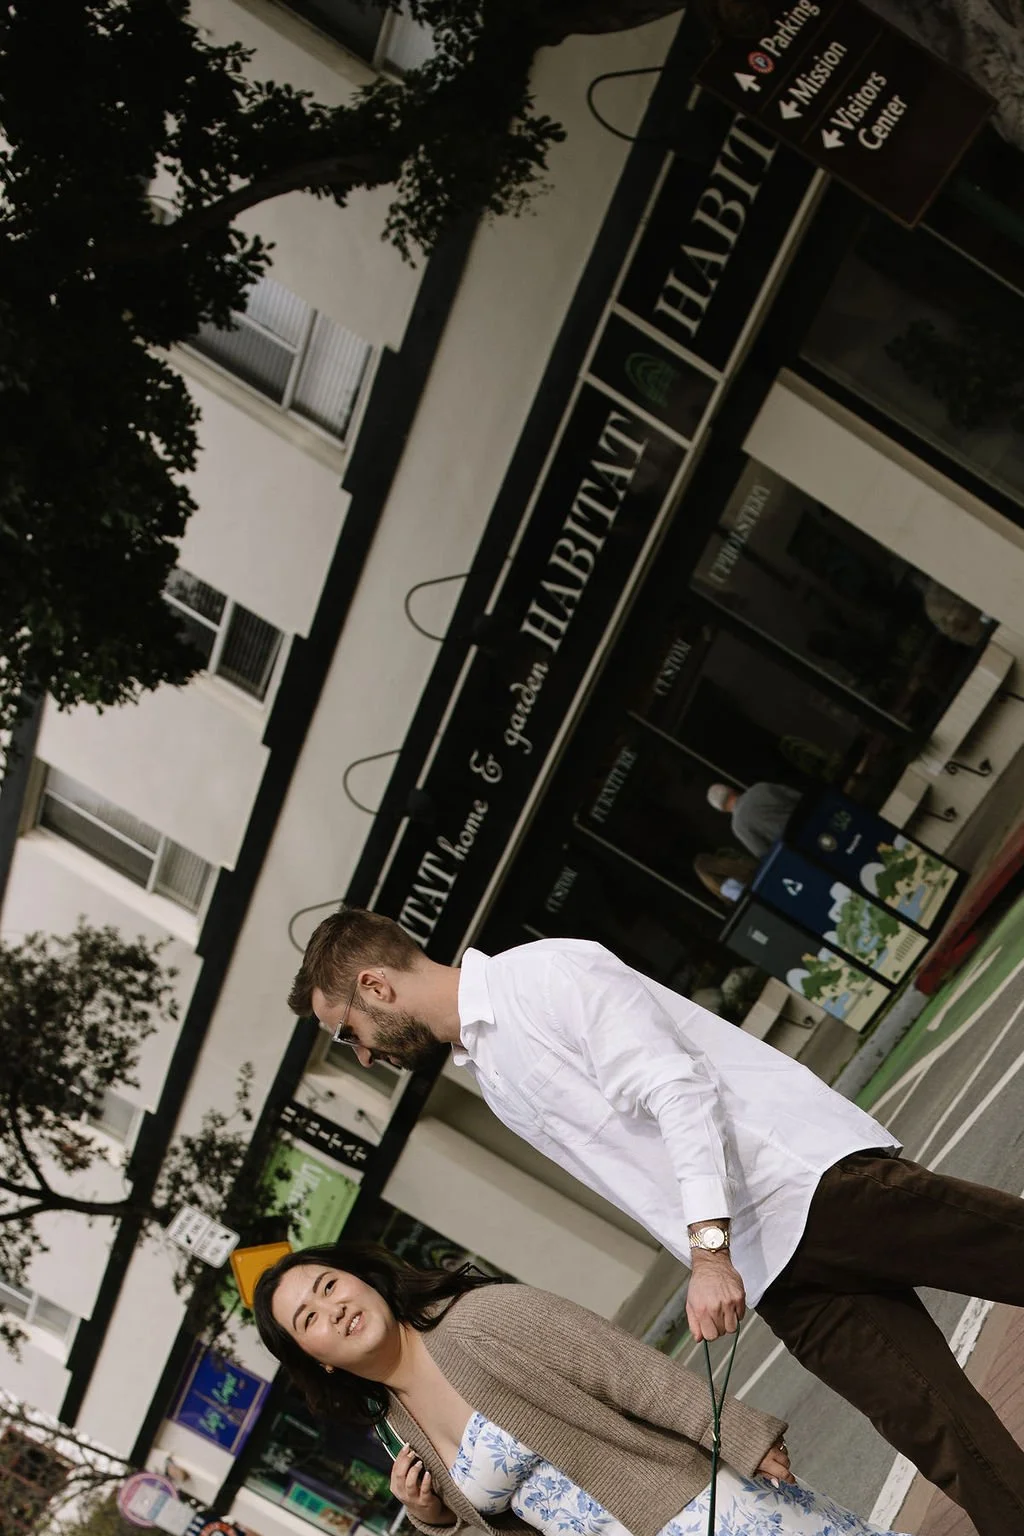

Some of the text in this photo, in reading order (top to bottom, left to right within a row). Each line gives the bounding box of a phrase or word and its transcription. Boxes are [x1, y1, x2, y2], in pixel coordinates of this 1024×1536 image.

[759, 0, 821, 58] Parking
[754, 56, 767, 68] P
[787, 41, 848, 106] Mission
[829, 71, 888, 131] Visitors
[858, 95, 908, 150] Center
[653, 112, 781, 338] HABIT
[651, 484, 771, 698] CUSTOM UPHOLSTERY
[398, 409, 649, 949] ITAT home & garden HABITAT
[544, 746, 639, 914] CUSTOM FURNITURE
